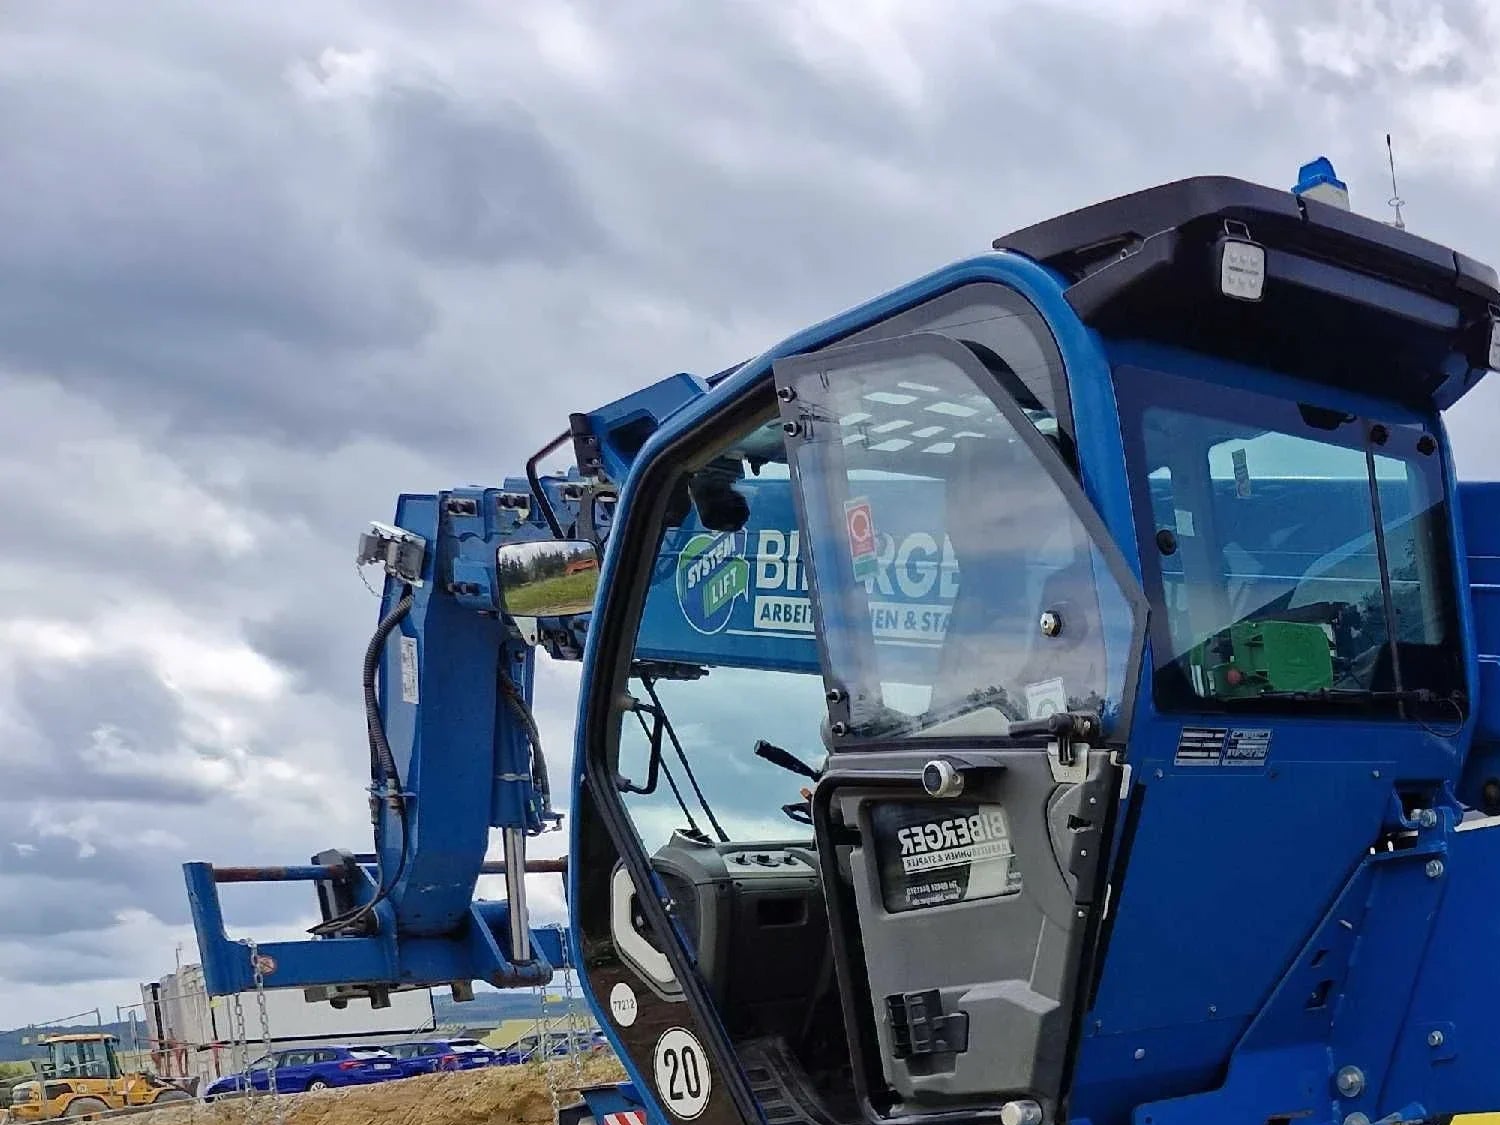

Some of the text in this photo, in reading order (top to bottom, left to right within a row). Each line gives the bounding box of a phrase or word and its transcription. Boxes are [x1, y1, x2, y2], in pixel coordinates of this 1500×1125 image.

[688, 532, 737, 589] SYSTEM
[712, 567, 737, 604] LIFT
[904, 610, 917, 630] &
[663, 1045, 702, 1101] 20
